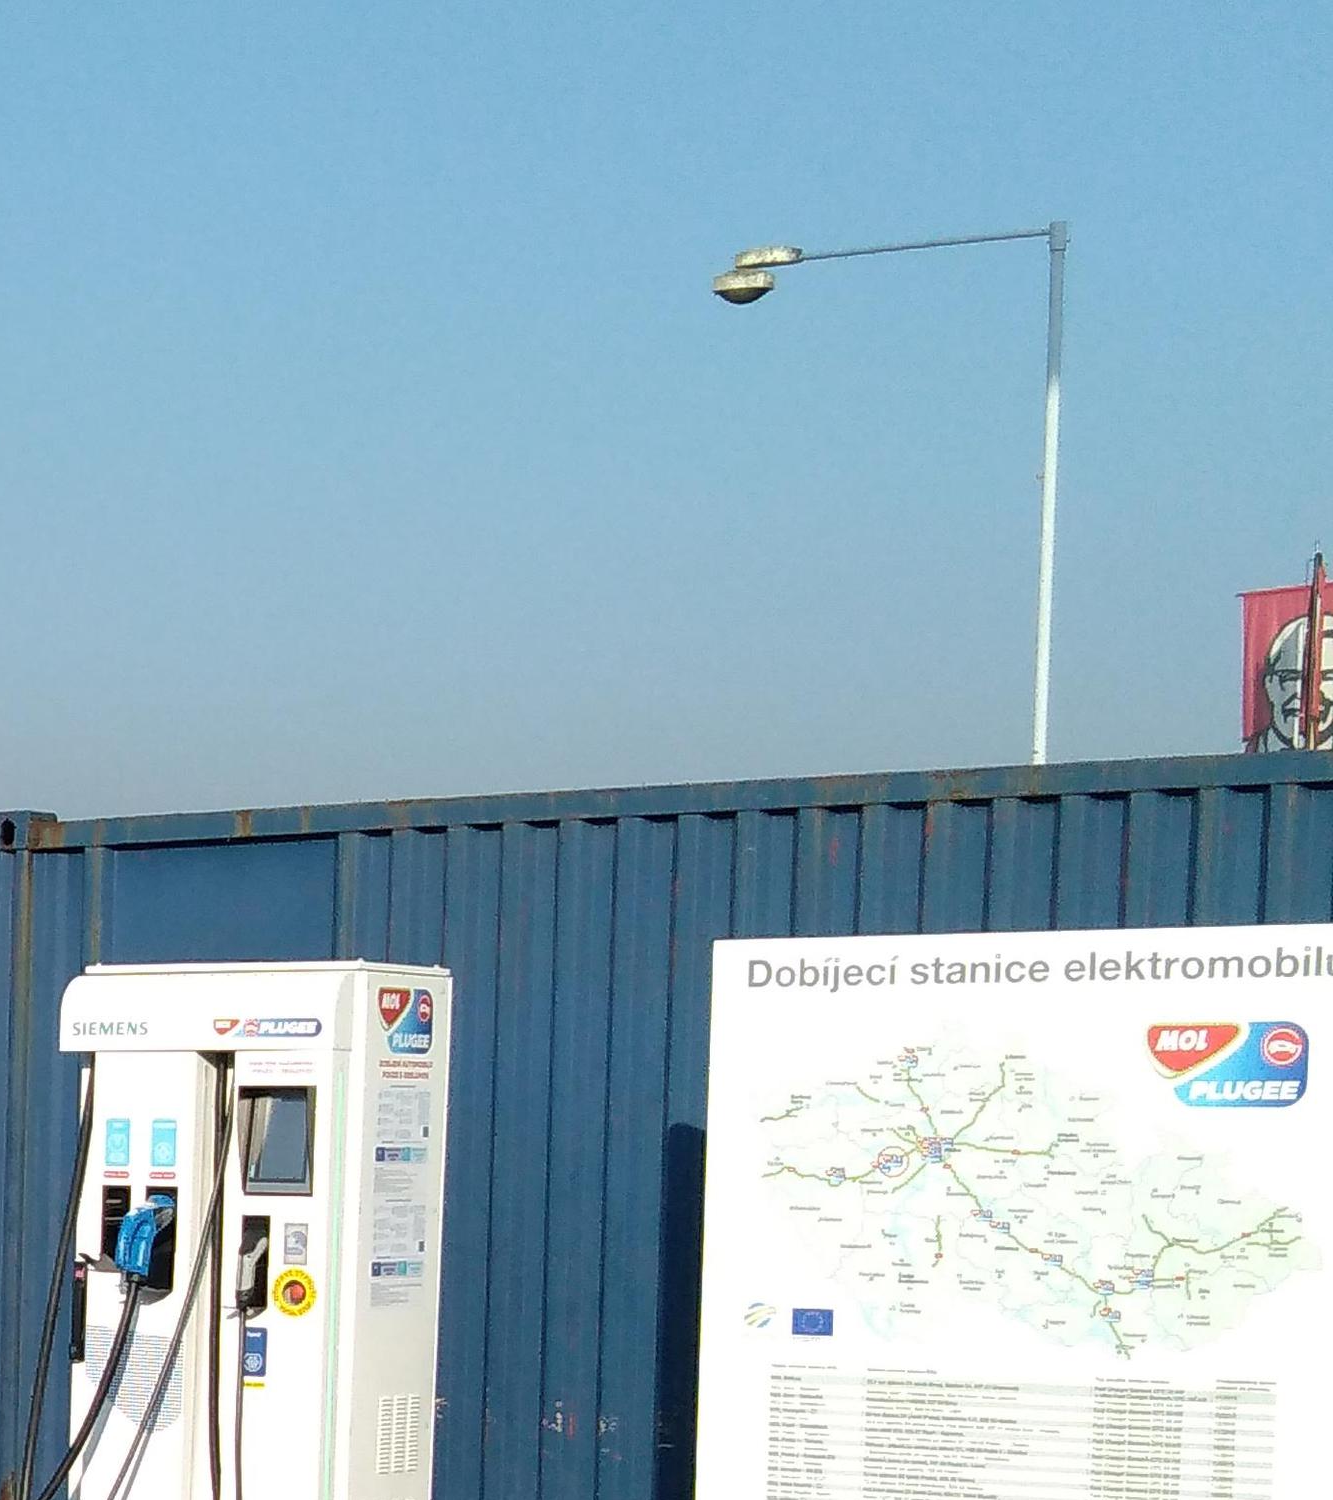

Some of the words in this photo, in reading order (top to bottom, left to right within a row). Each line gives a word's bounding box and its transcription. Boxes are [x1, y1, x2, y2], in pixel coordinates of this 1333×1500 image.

[747, 955, 900, 993] Dobíjecí
[909, 953, 1050, 985] stanice
[72, 1021, 149, 1037] SIEMENS
[260, 1021, 318, 1034] PLUGEE
[392, 1033, 431, 1049] PLUGEE
[1154, 1029, 1209, 1053] MOL
[1188, 1079, 1301, 1101] PLUGEE
